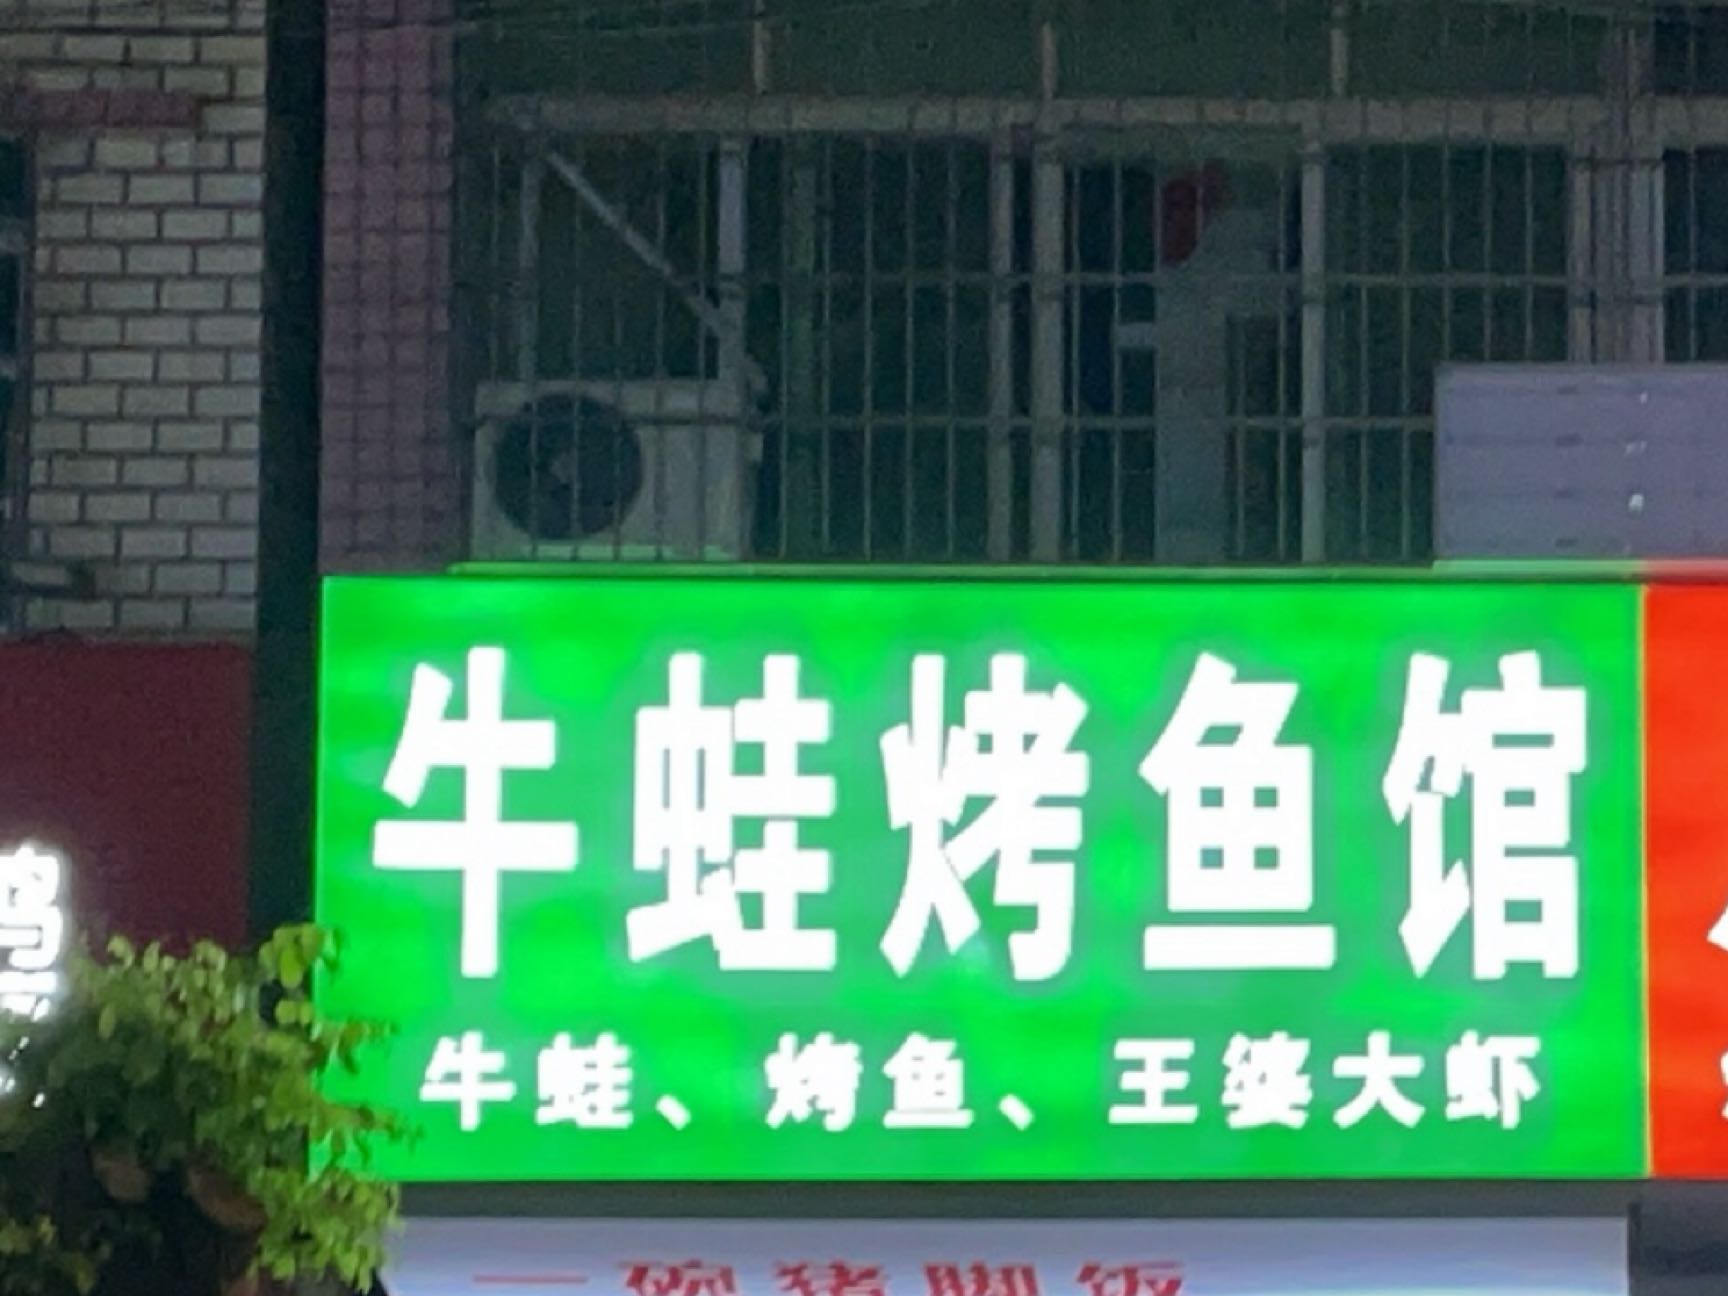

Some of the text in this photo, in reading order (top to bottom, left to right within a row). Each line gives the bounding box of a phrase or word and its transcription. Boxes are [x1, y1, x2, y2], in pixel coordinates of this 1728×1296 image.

[372, 646, 1588, 980] 牛蛙烤鱼馆
